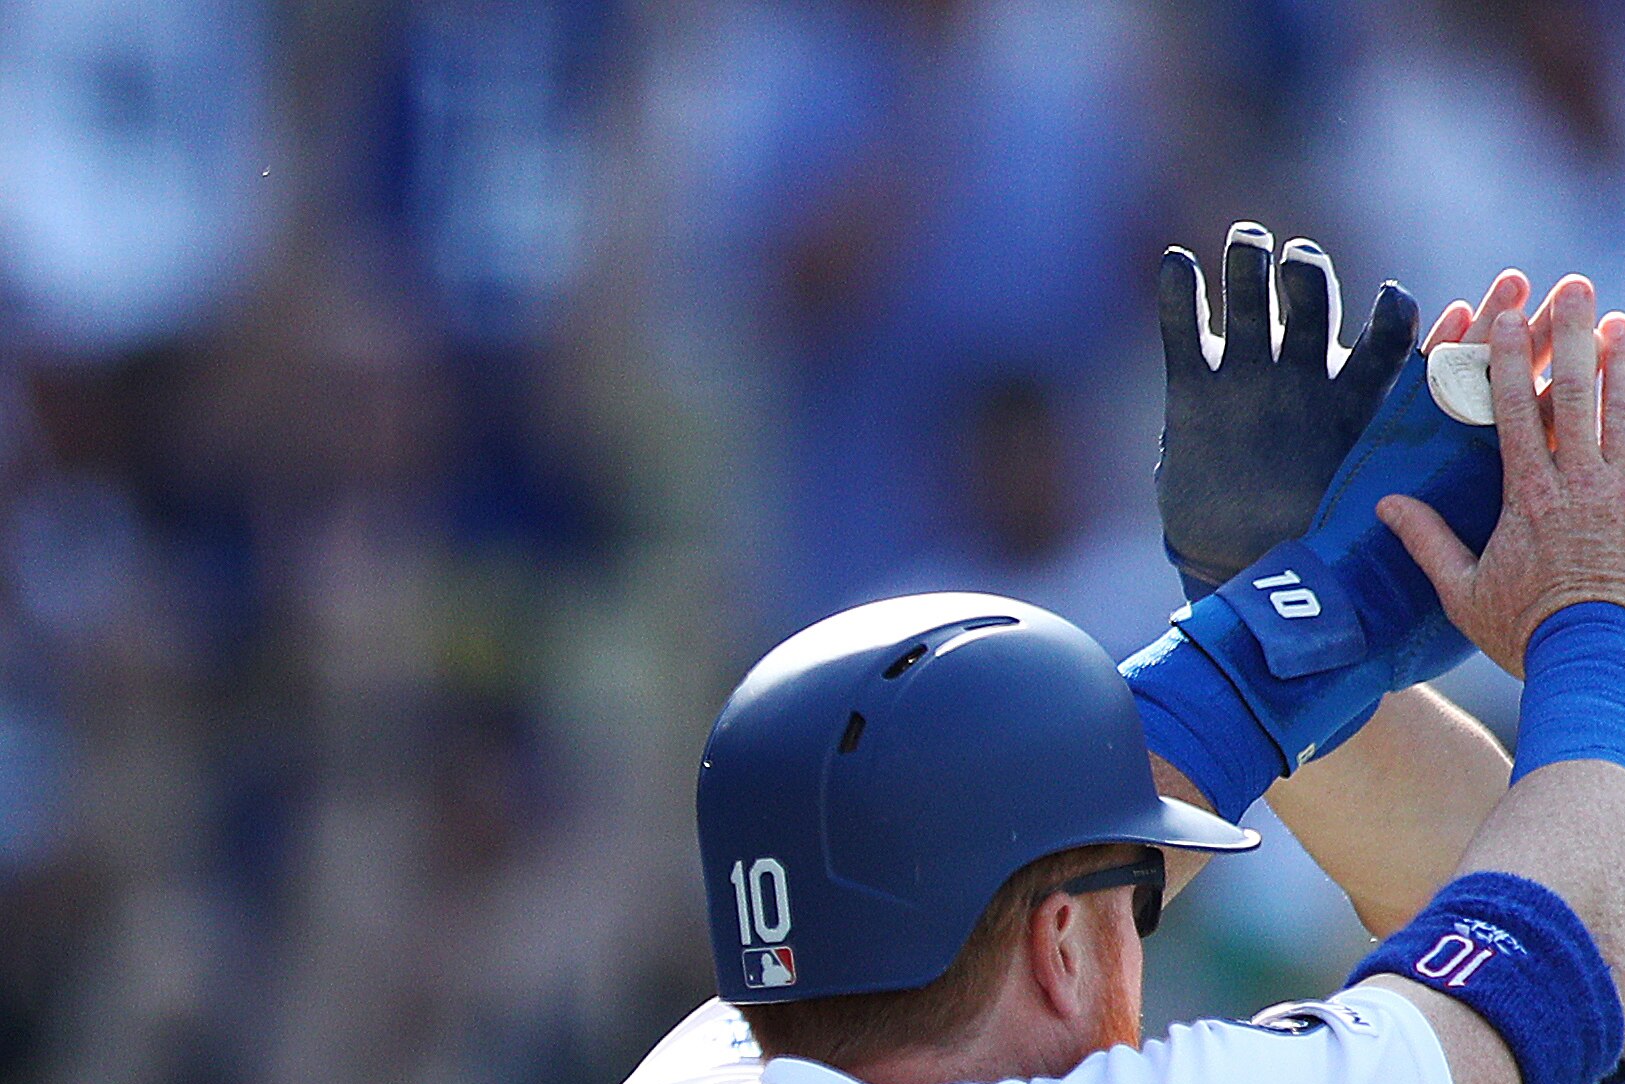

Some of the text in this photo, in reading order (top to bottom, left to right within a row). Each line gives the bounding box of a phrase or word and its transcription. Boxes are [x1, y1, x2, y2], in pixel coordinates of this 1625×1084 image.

[1252, 570, 1321, 619] 10
[730, 858, 791, 945] 10
[1414, 933, 1496, 987] 10
